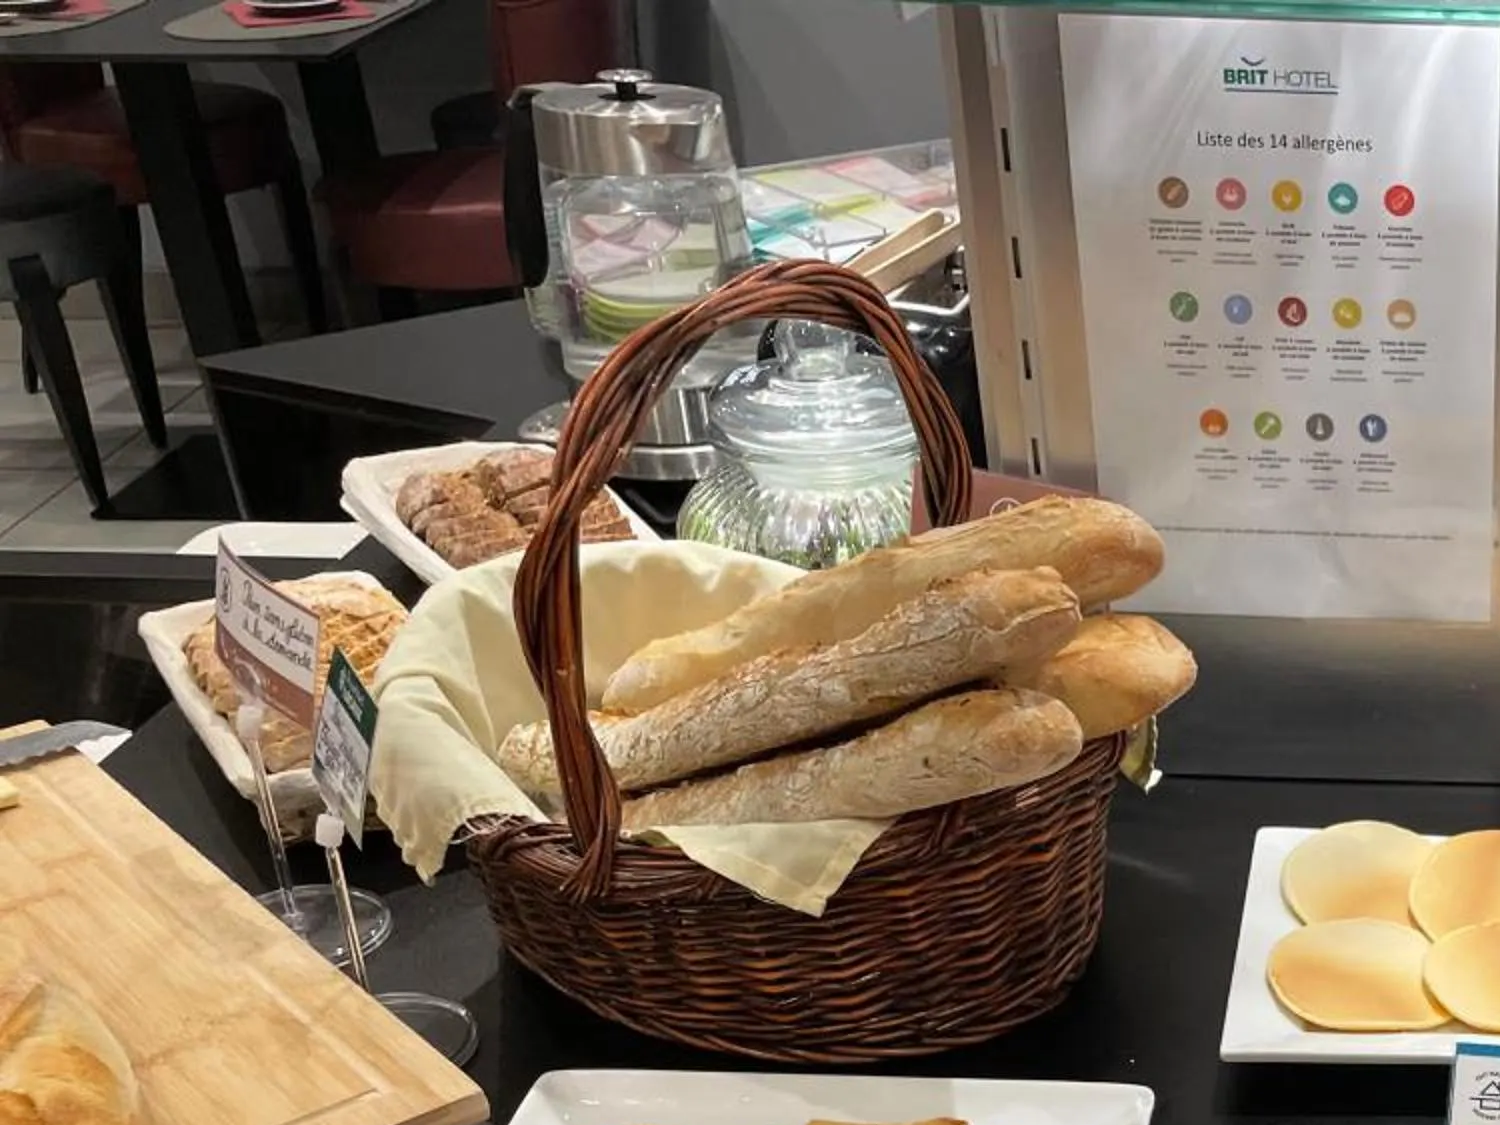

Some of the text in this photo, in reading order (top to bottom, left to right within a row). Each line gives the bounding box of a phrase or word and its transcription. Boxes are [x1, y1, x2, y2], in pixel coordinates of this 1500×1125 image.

[1223, 68, 1338, 89] BRIT HOTEL
[1197, 131, 1373, 154] Liste des 14 allergènes
